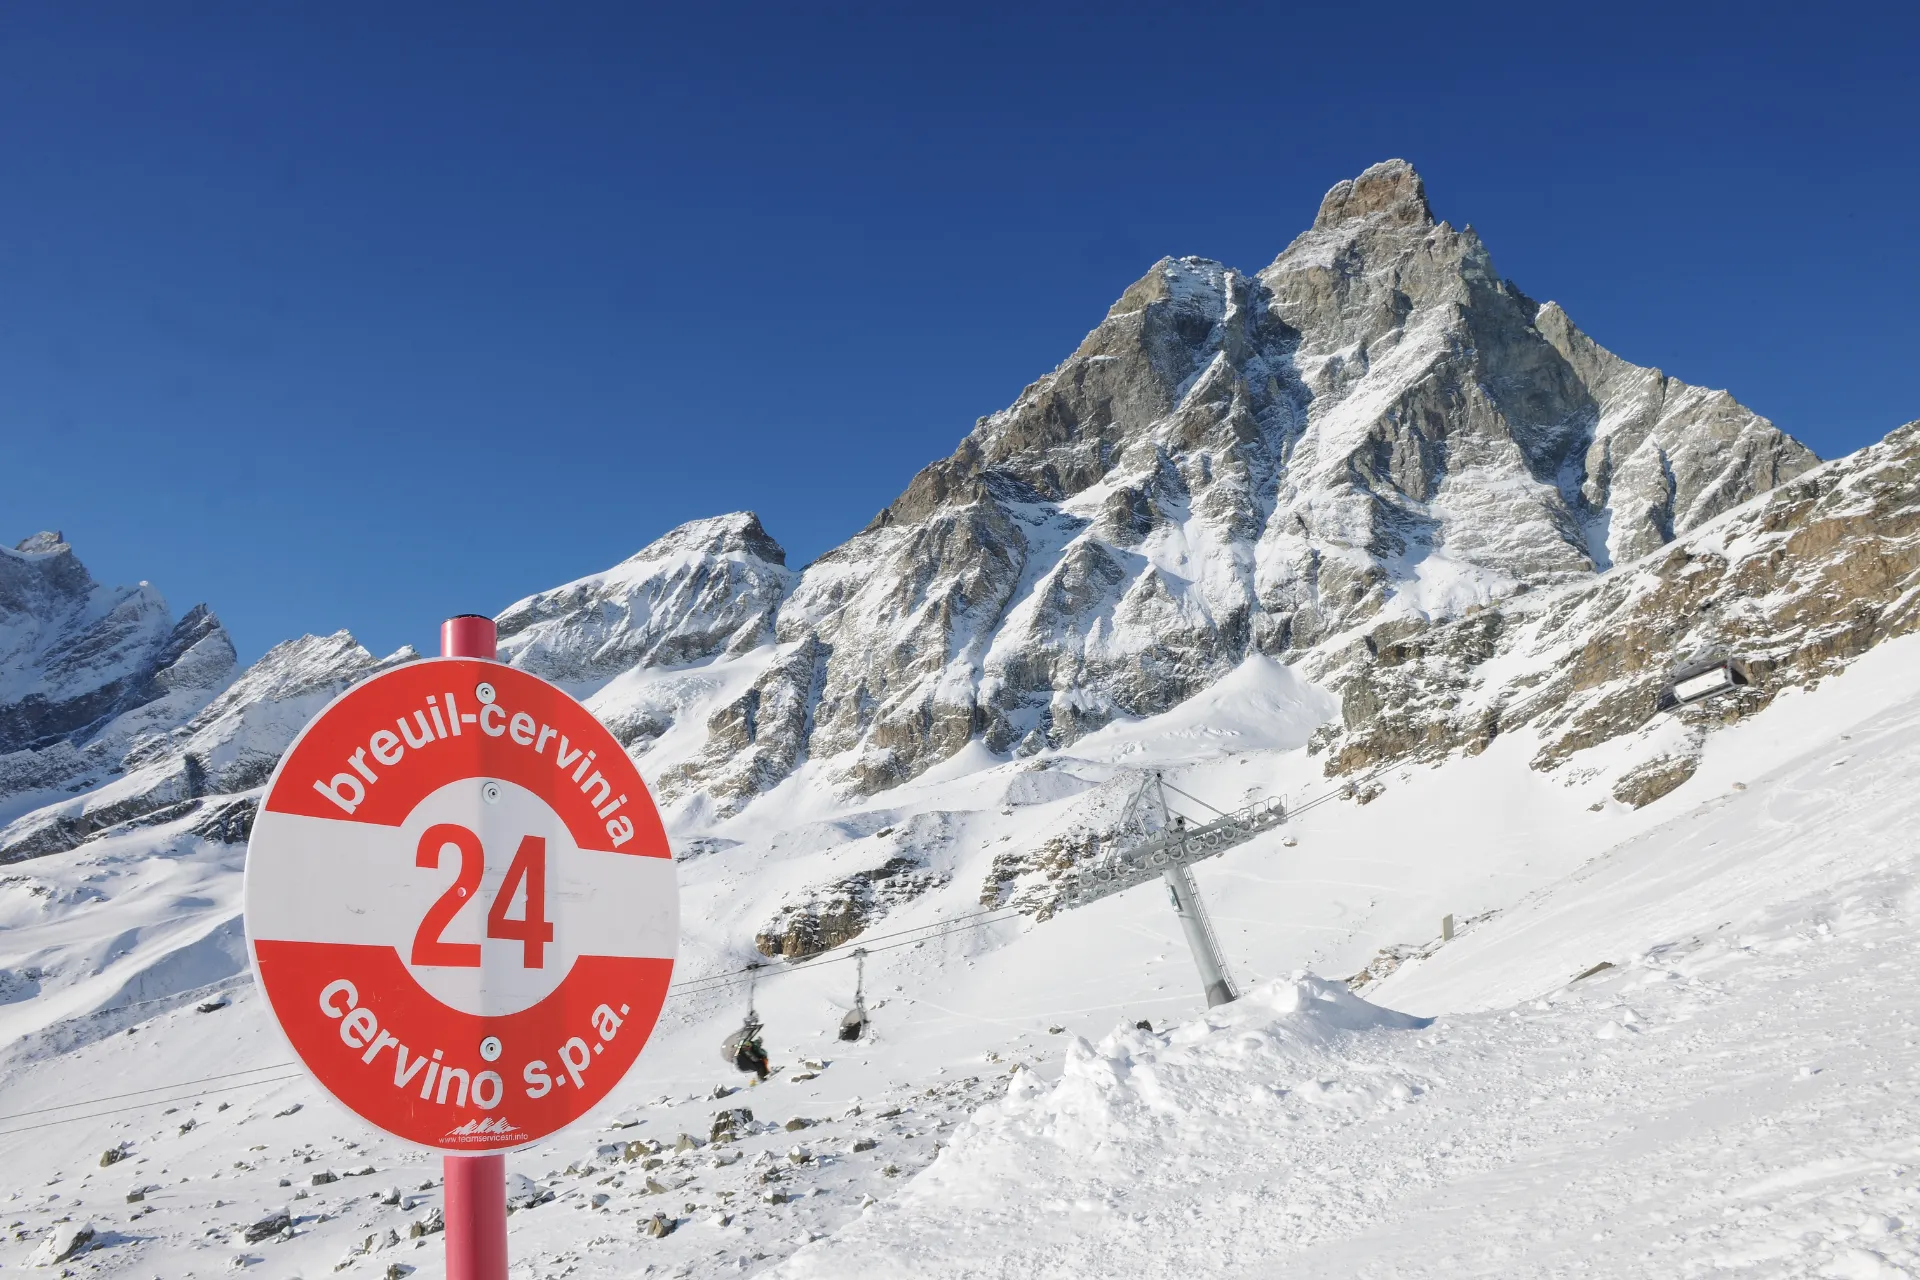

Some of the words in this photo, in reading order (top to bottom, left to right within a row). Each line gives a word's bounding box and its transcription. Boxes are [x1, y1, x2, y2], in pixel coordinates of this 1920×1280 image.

[313, 692, 634, 847] breuil-cervinia
[411, 823, 554, 969] 24
[320, 978, 503, 1109] cervino
[523, 1003, 630, 1098] s.p.a.
[438, 1132, 529, 1144] www.teamservicesrl.info
